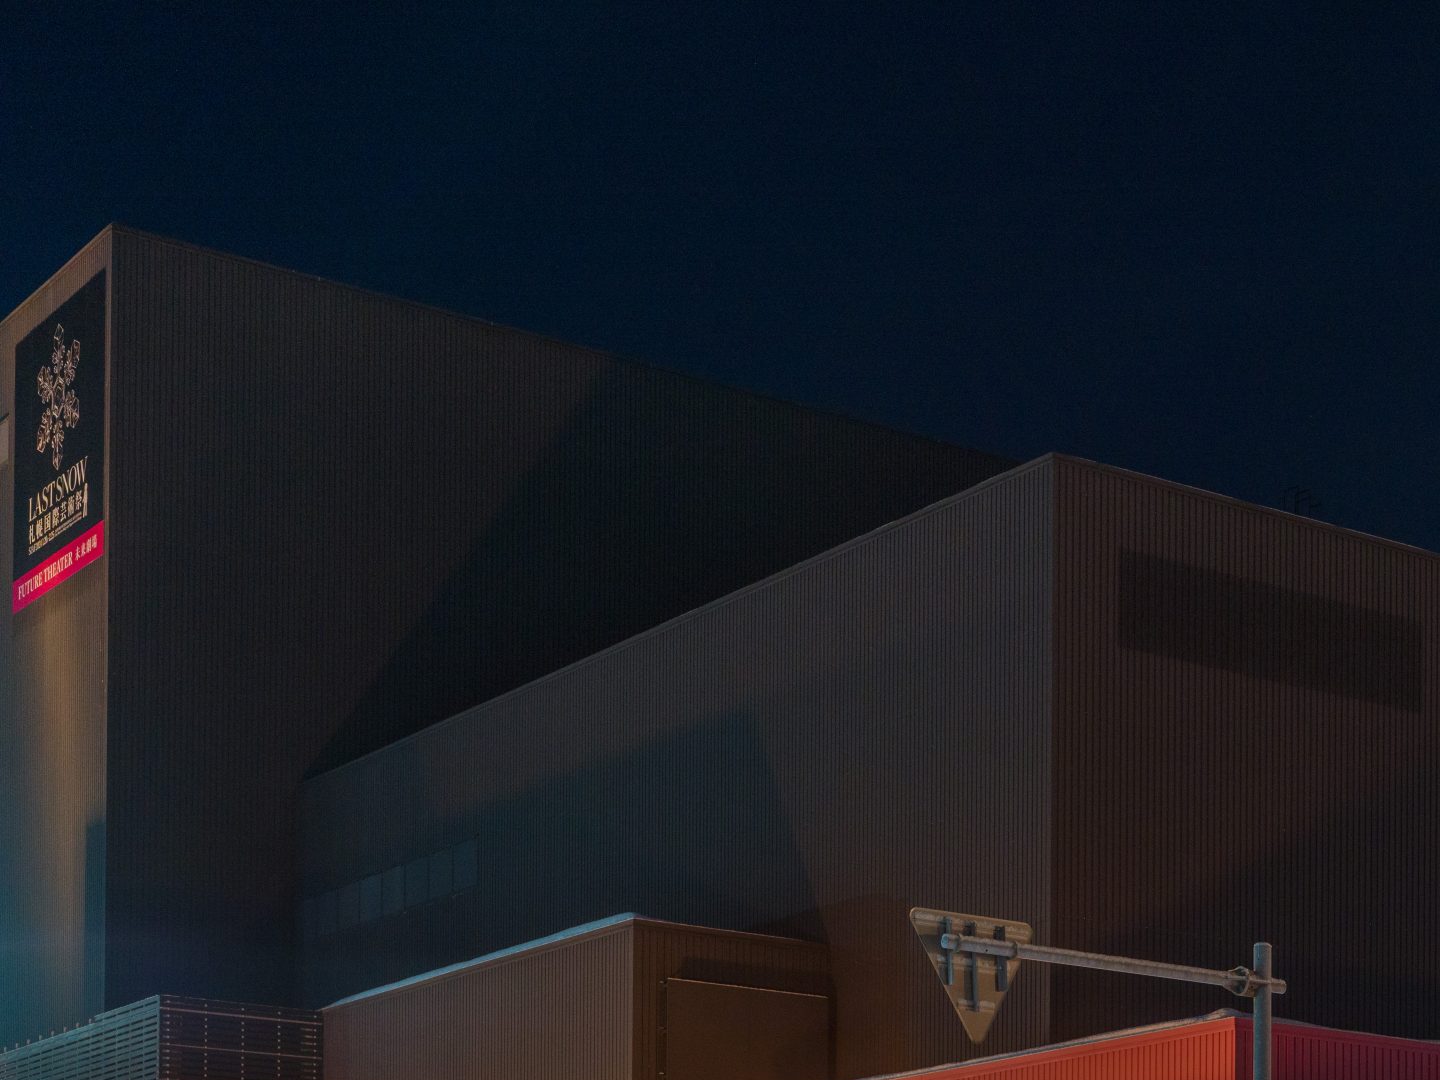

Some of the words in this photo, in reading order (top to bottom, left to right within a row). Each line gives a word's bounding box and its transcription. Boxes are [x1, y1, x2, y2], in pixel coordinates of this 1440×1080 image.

[28, 480, 56, 522] LAST
[56, 455, 88, 502] SNOW
[18, 571, 43, 600] FUTURE
[43, 551, 73, 583] THEATER
